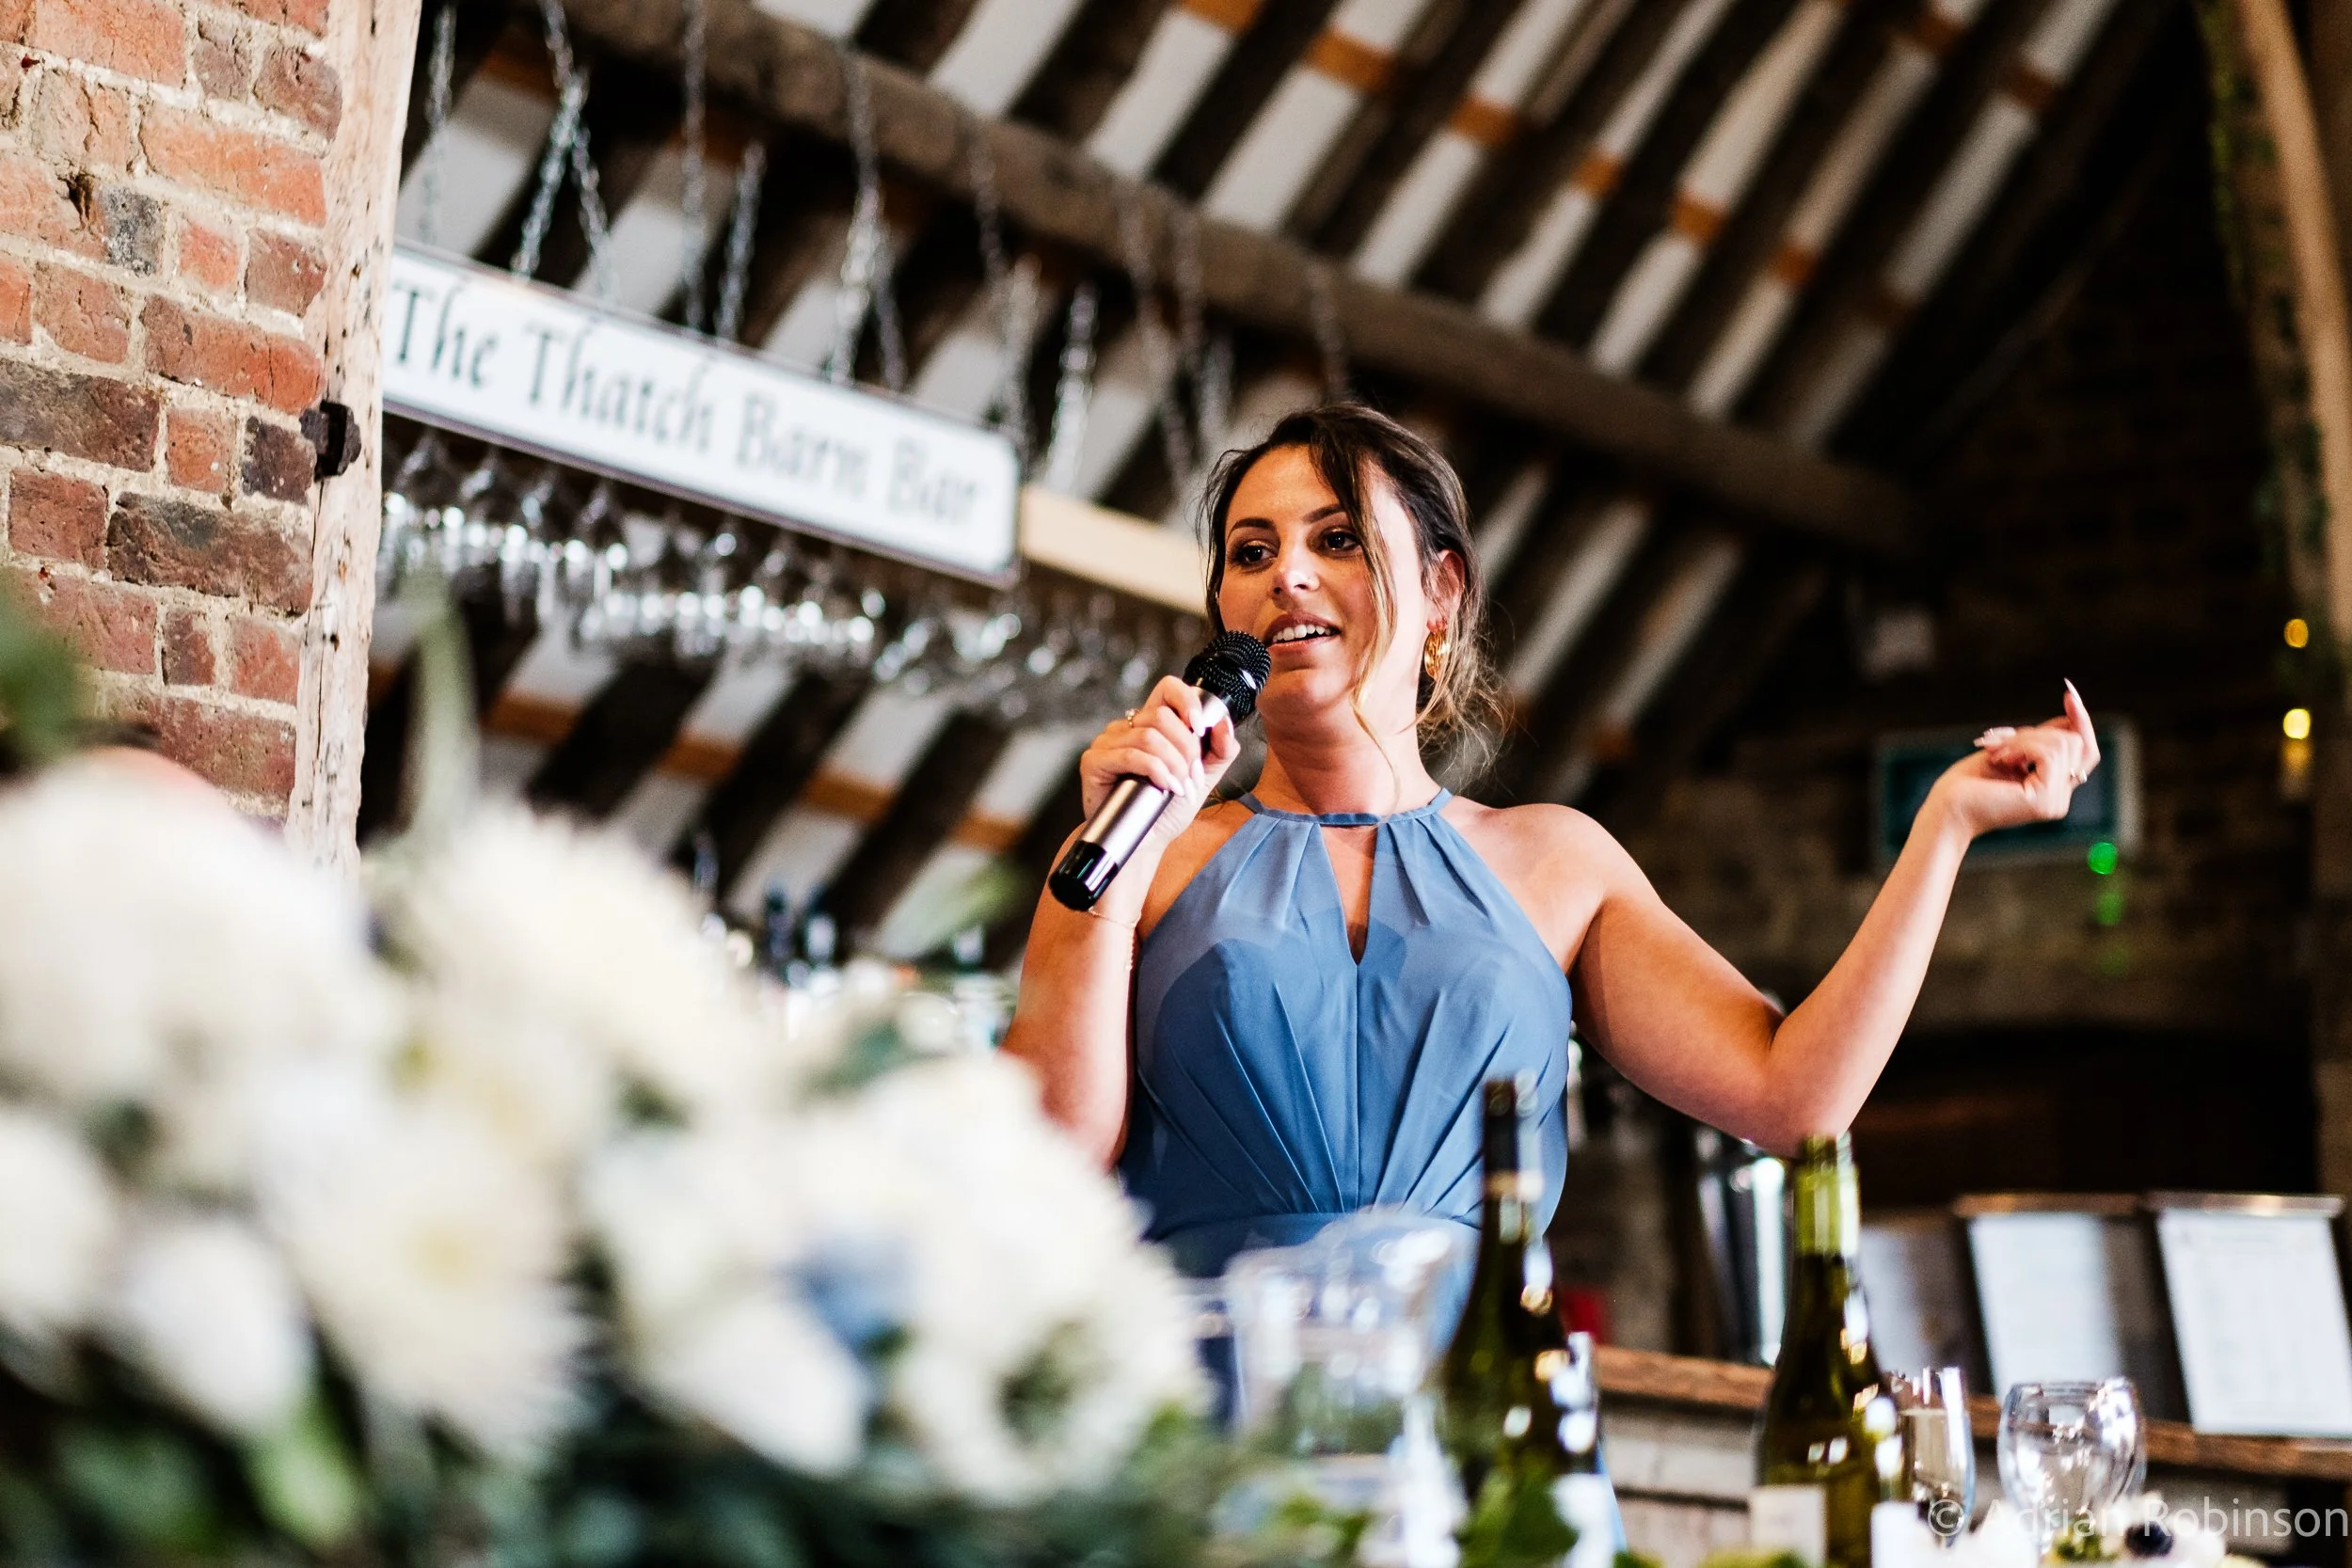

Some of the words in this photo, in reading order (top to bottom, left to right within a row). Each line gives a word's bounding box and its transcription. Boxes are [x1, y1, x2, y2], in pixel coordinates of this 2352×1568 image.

[393, 275, 500, 389] The
[524, 317, 716, 454] Thatch
[734, 388, 871, 502] Barn
[887, 433, 978, 525] Bar
